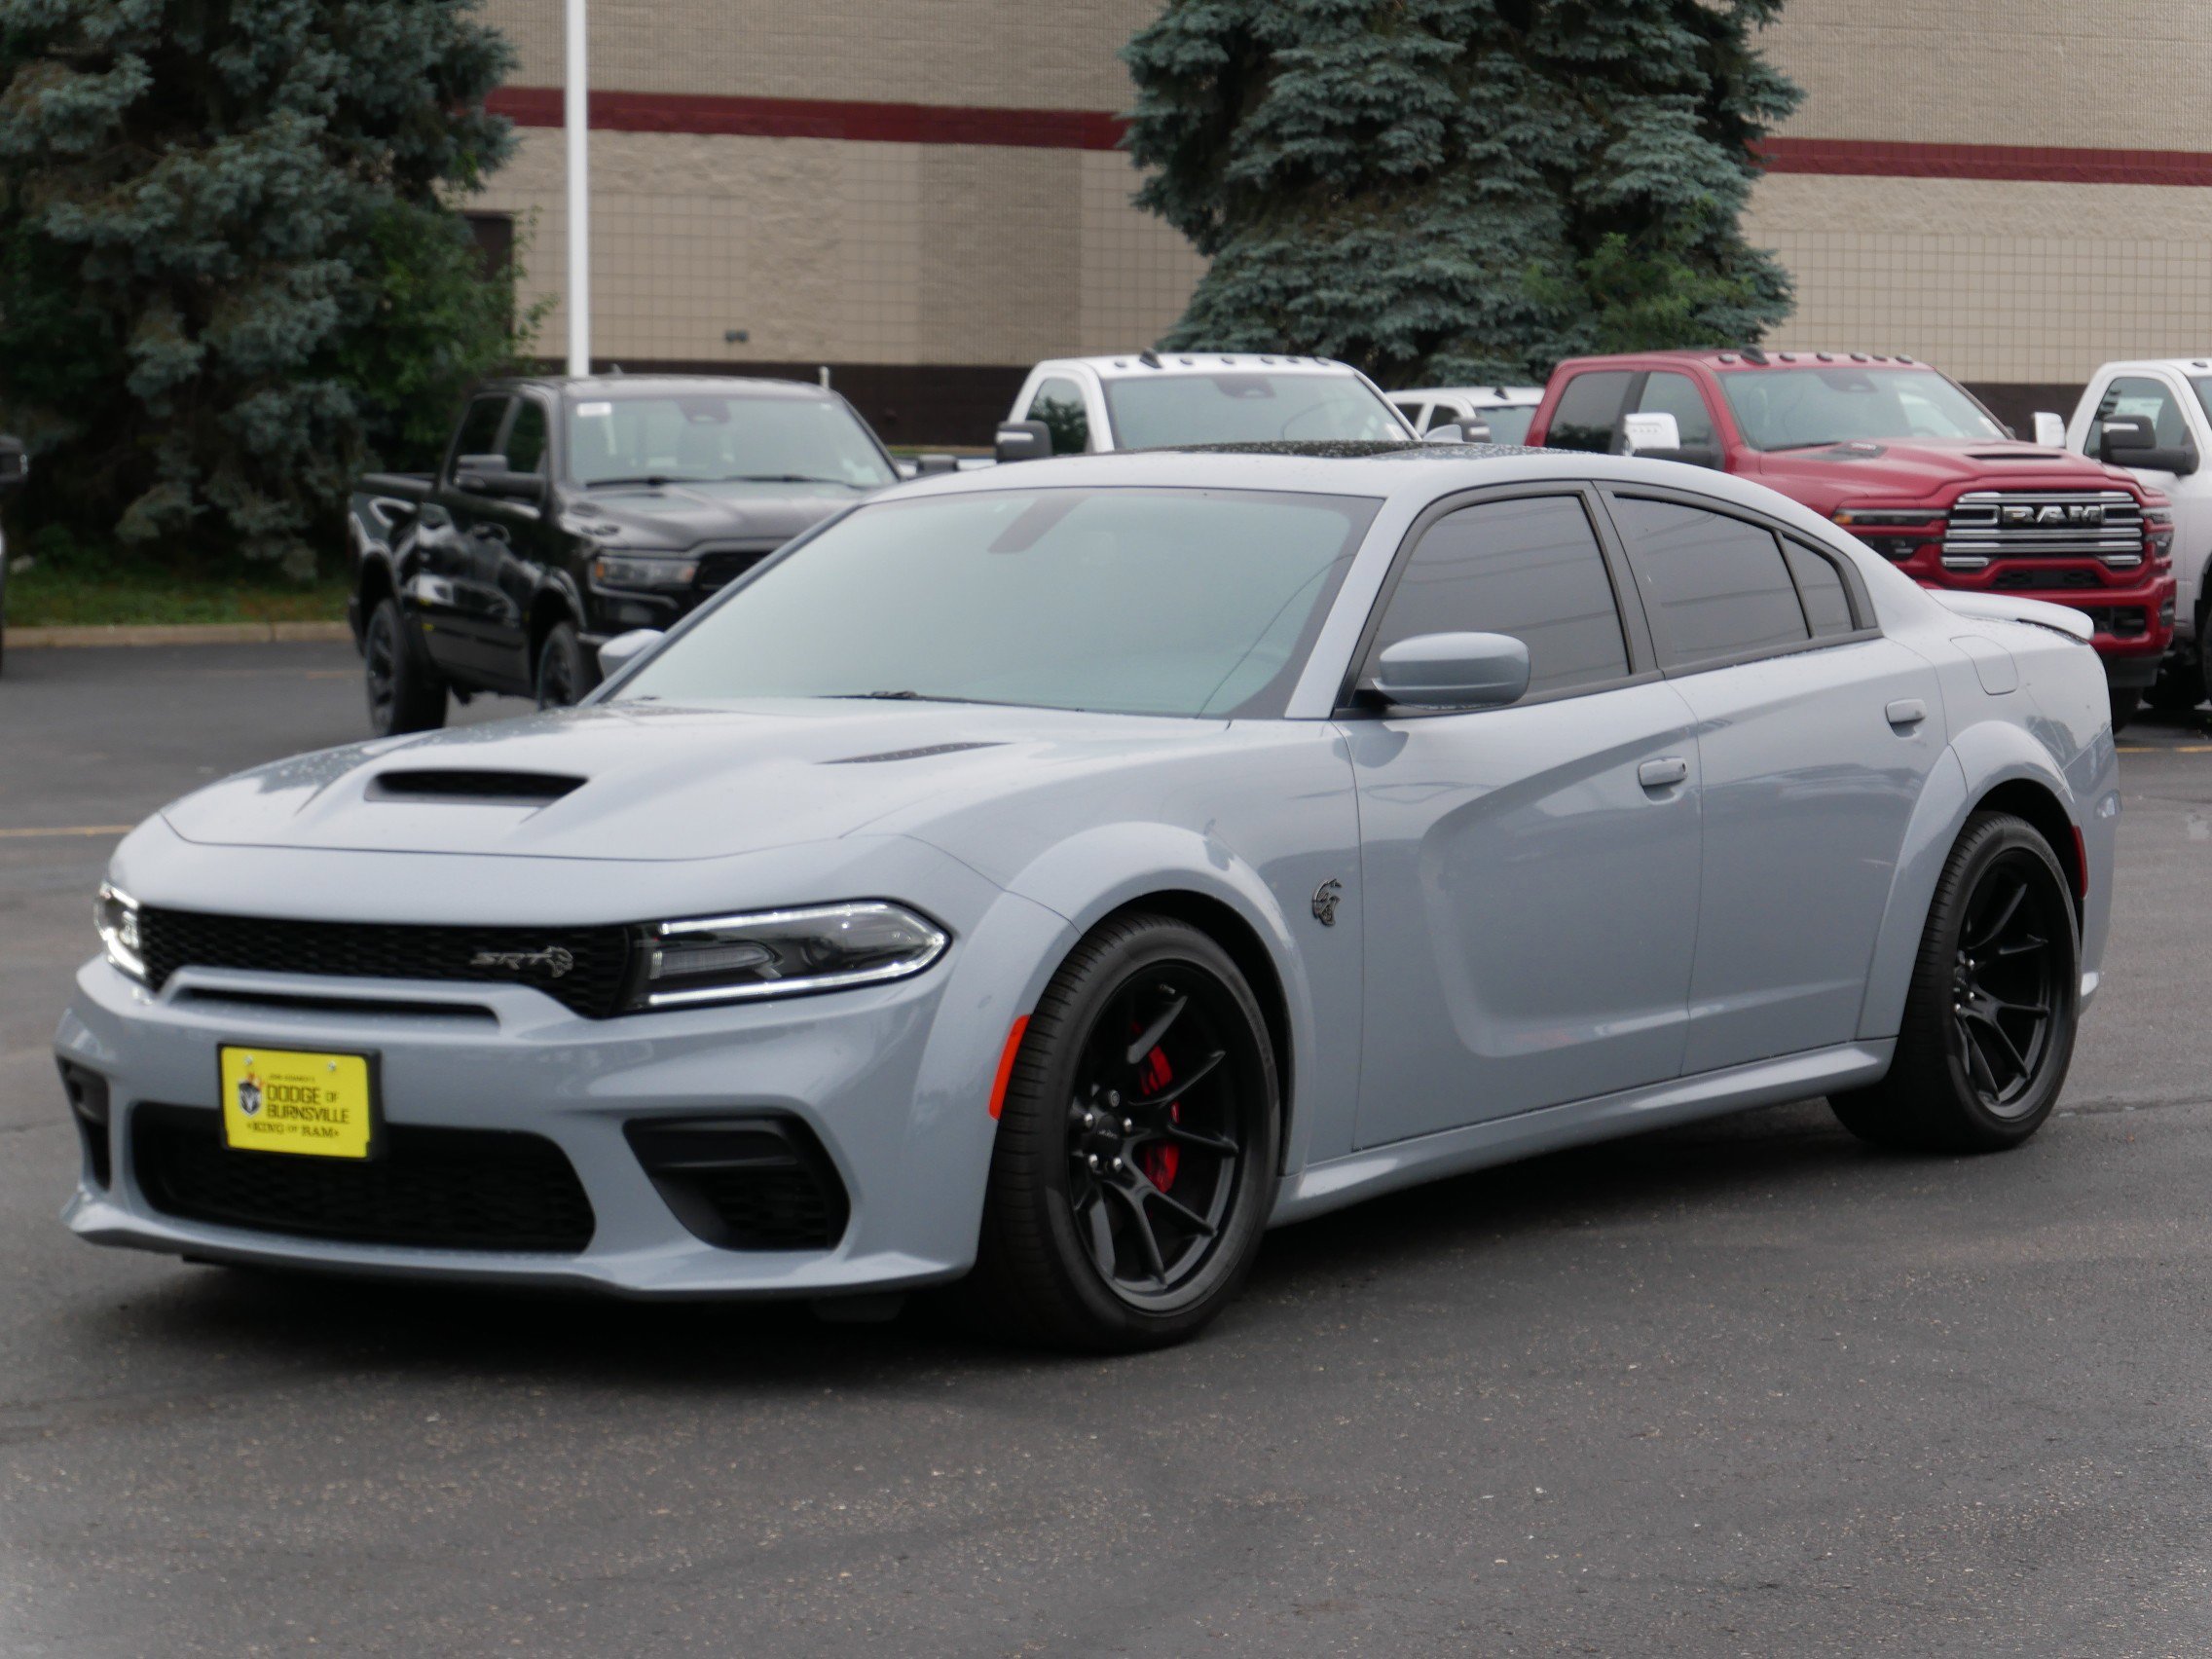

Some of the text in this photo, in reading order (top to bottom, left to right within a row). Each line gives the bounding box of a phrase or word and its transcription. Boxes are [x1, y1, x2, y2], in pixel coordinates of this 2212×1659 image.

[2002, 505, 2101, 523] RAM
[267, 1085, 338, 1104] DODGE OF
[267, 1104, 350, 1124] BURNSVILLE
